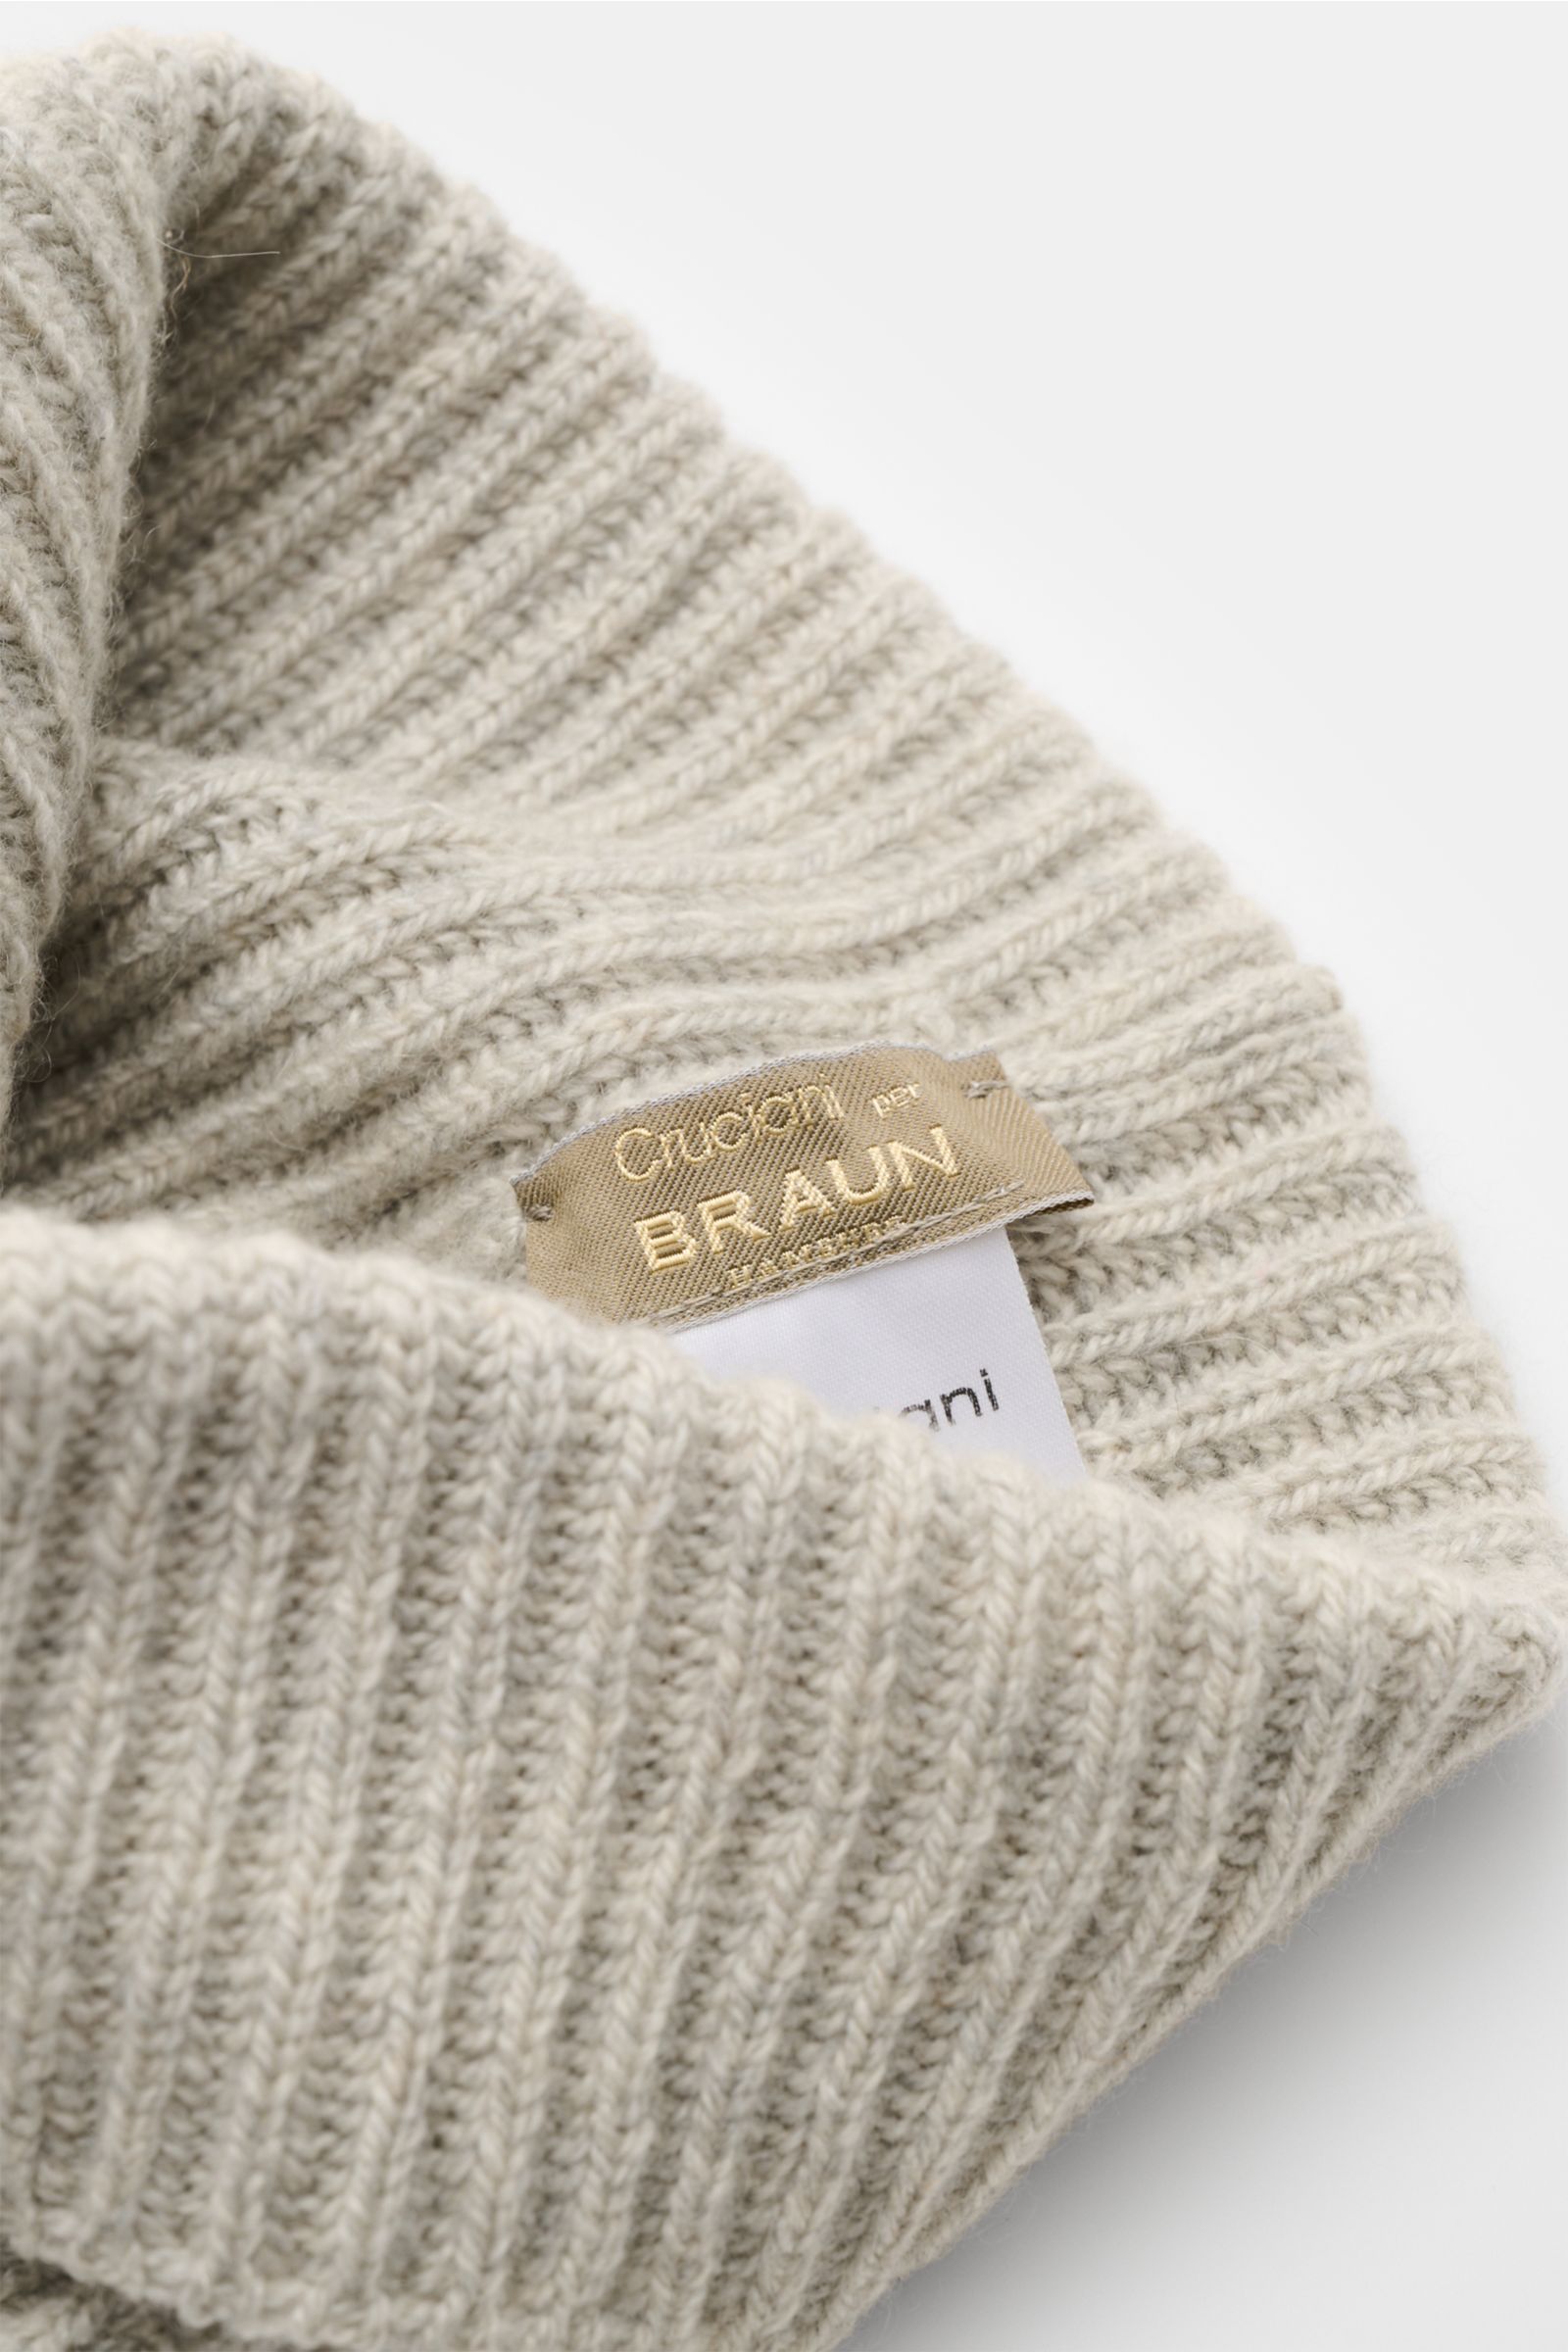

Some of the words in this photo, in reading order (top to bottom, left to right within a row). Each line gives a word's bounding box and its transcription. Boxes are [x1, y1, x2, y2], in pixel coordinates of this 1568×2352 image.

[614, 1073, 845, 1181] Cruciani
[871, 1083, 920, 1118] per
[634, 1124, 959, 1274] BRAUN
[872, 1368, 1000, 1432] ani
